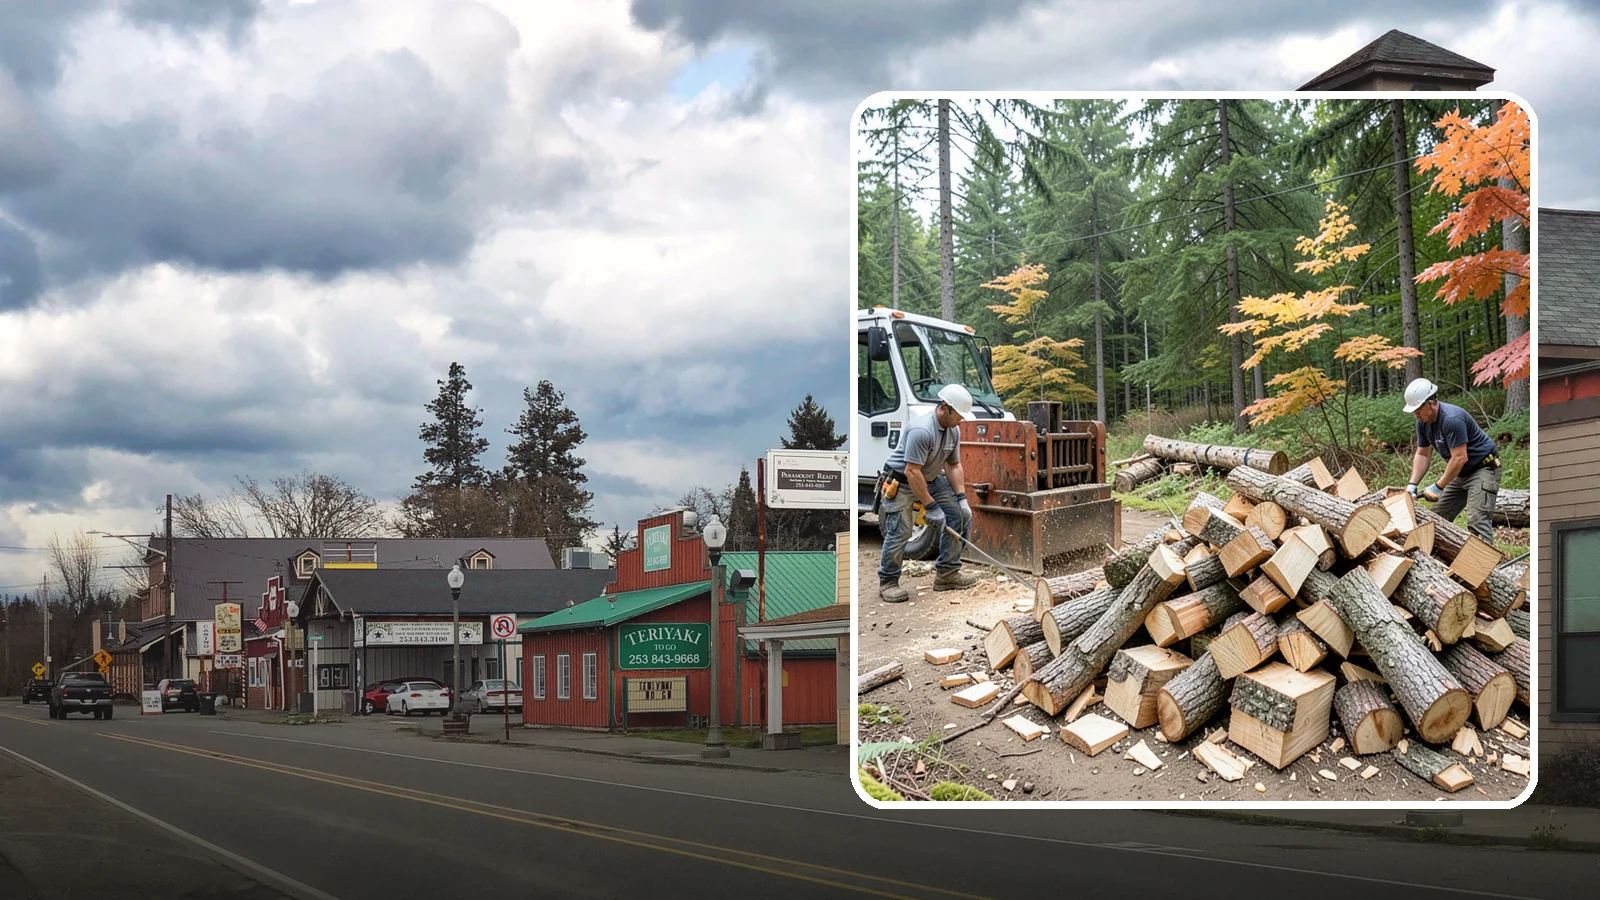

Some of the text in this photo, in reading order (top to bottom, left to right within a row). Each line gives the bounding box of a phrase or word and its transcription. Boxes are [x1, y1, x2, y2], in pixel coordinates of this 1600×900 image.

[625, 627, 702, 646] TERIYAKI
[628, 653, 700, 665] 253 843-9668
